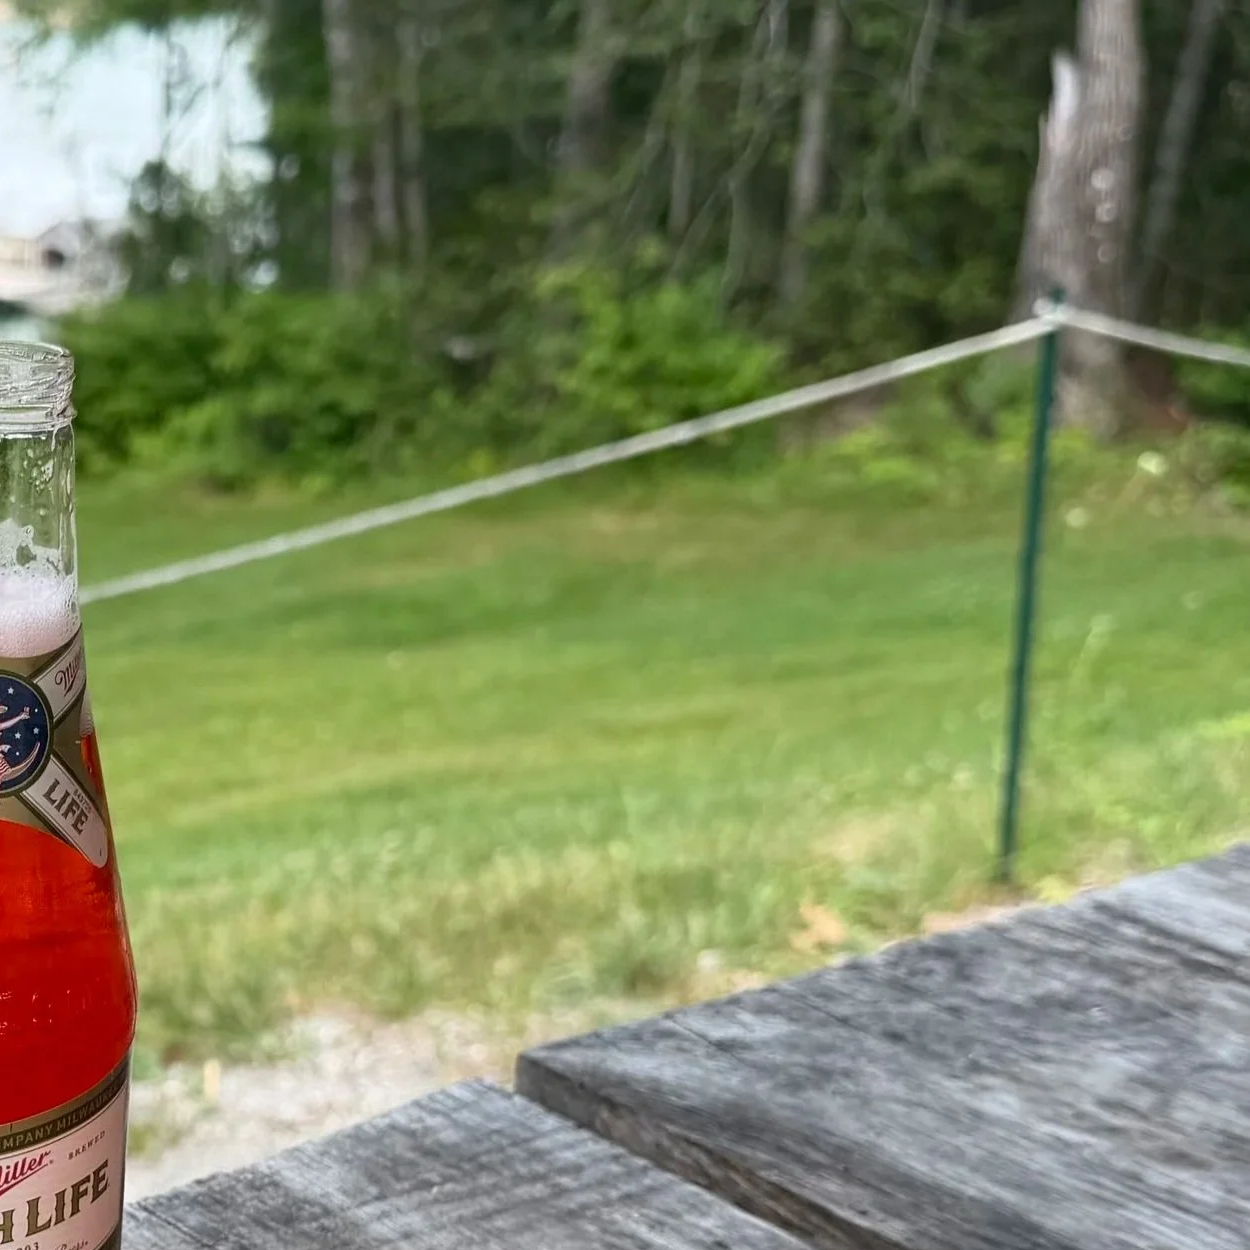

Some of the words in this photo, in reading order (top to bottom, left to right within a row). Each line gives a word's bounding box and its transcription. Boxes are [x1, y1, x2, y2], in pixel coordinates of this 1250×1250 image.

[43, 778, 89, 836] LIFE
[68, 1130, 106, 1160] BREWED
[26, 1158, 109, 1237] LIFE
